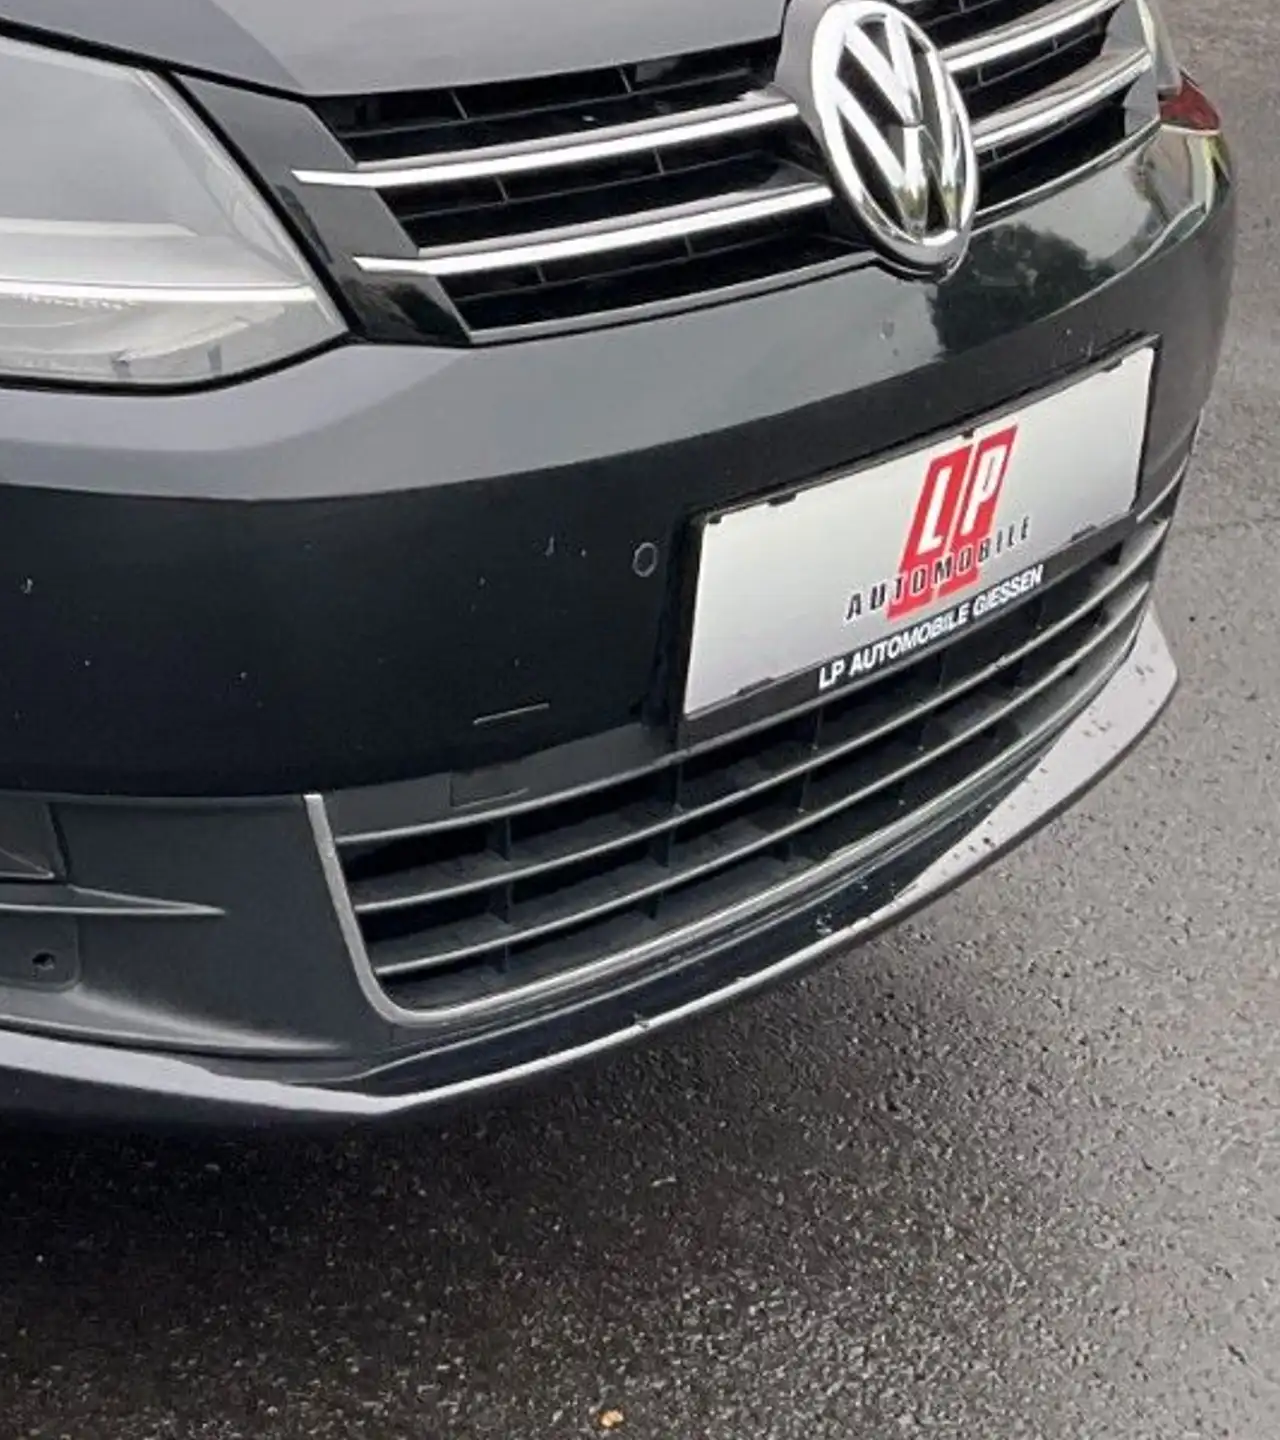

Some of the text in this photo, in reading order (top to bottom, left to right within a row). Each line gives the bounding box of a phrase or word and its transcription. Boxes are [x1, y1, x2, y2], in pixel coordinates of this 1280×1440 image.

[916, 443, 1009, 555] LP
[844, 515, 1030, 622] AUTOMOBILE
[818, 563, 1045, 690] LP AUTOMOBILE GIESSEN
